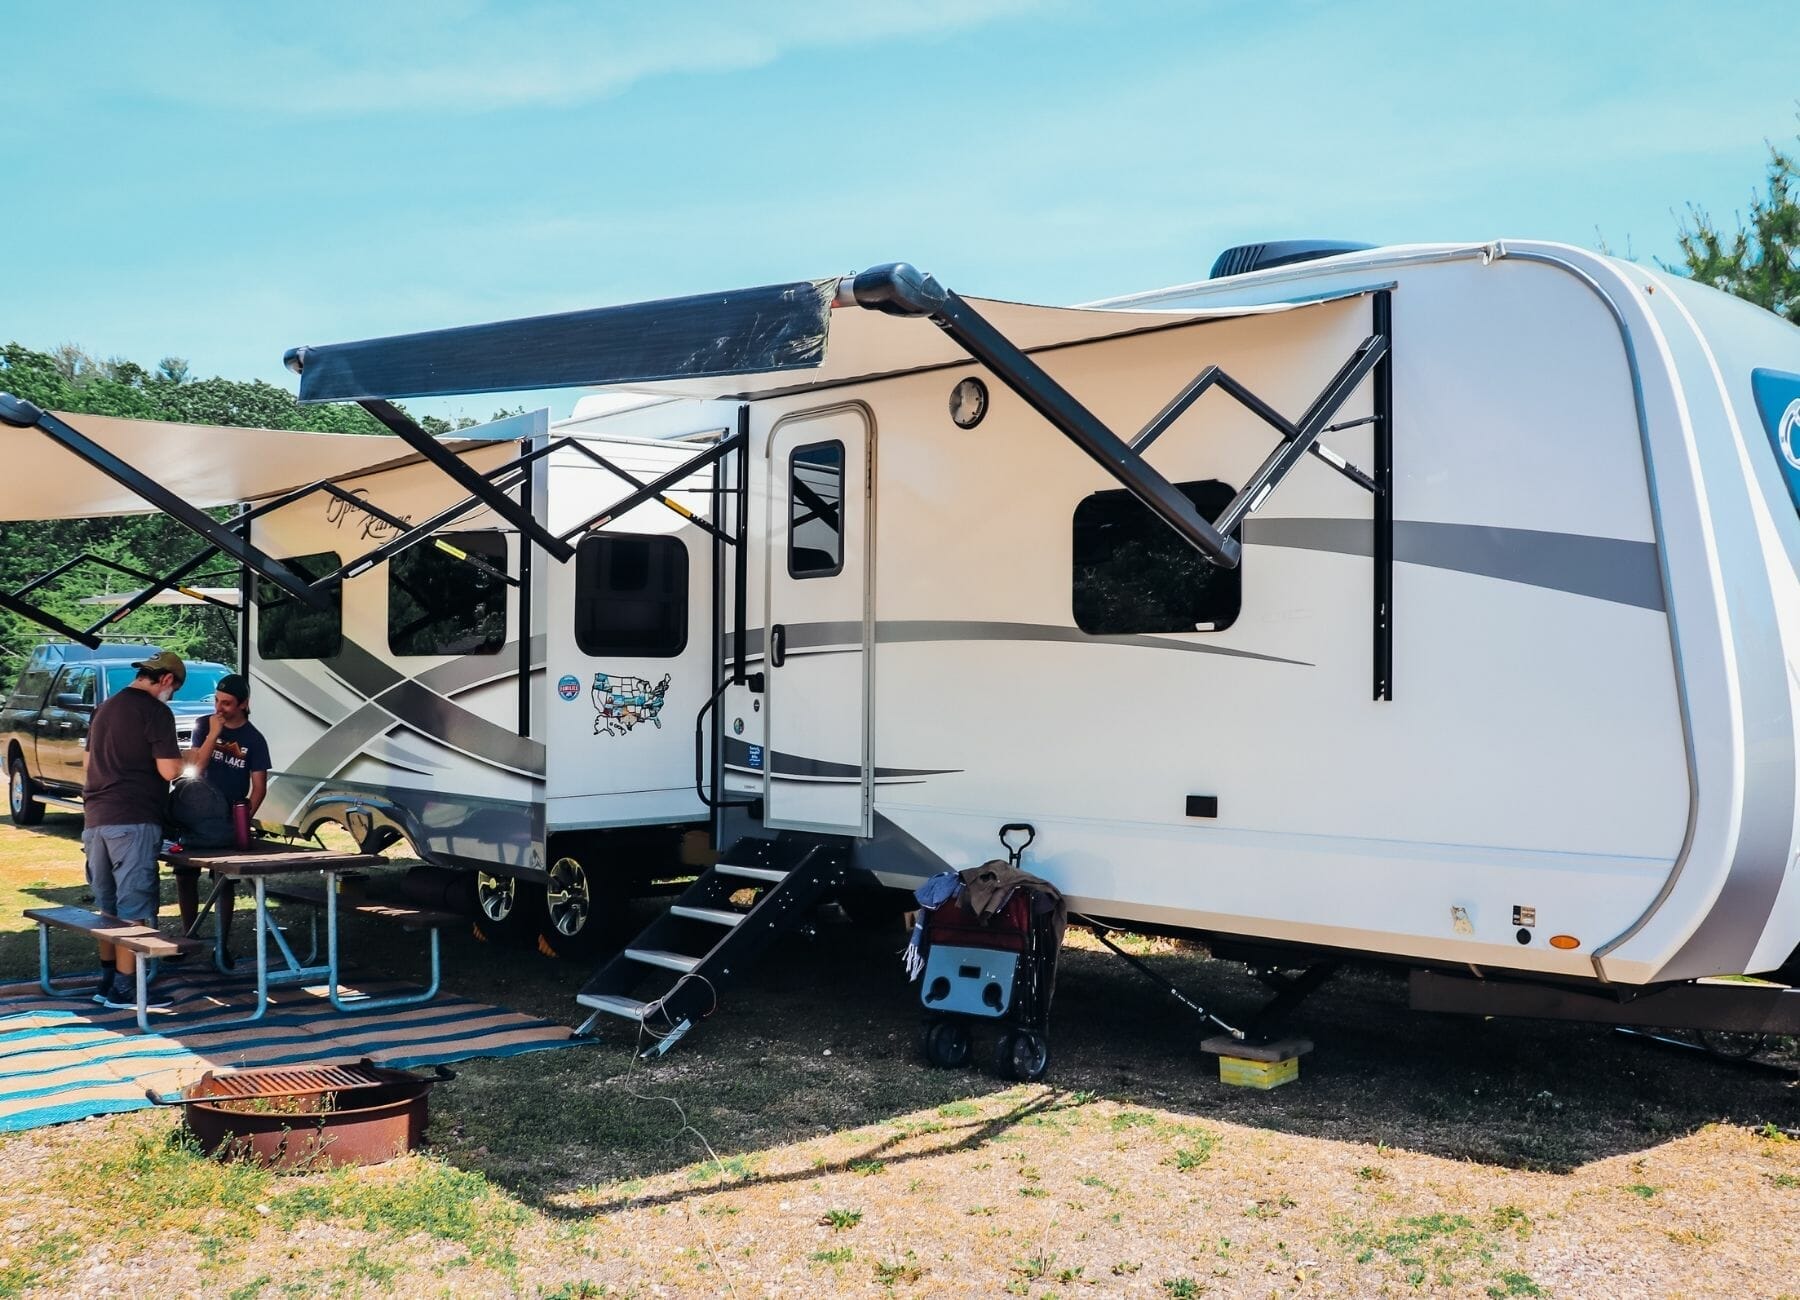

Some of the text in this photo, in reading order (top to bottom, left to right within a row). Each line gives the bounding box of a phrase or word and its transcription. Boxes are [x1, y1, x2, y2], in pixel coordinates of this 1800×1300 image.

[326, 488, 369, 529] Ope
[211, 750, 246, 768] TER LAKE
